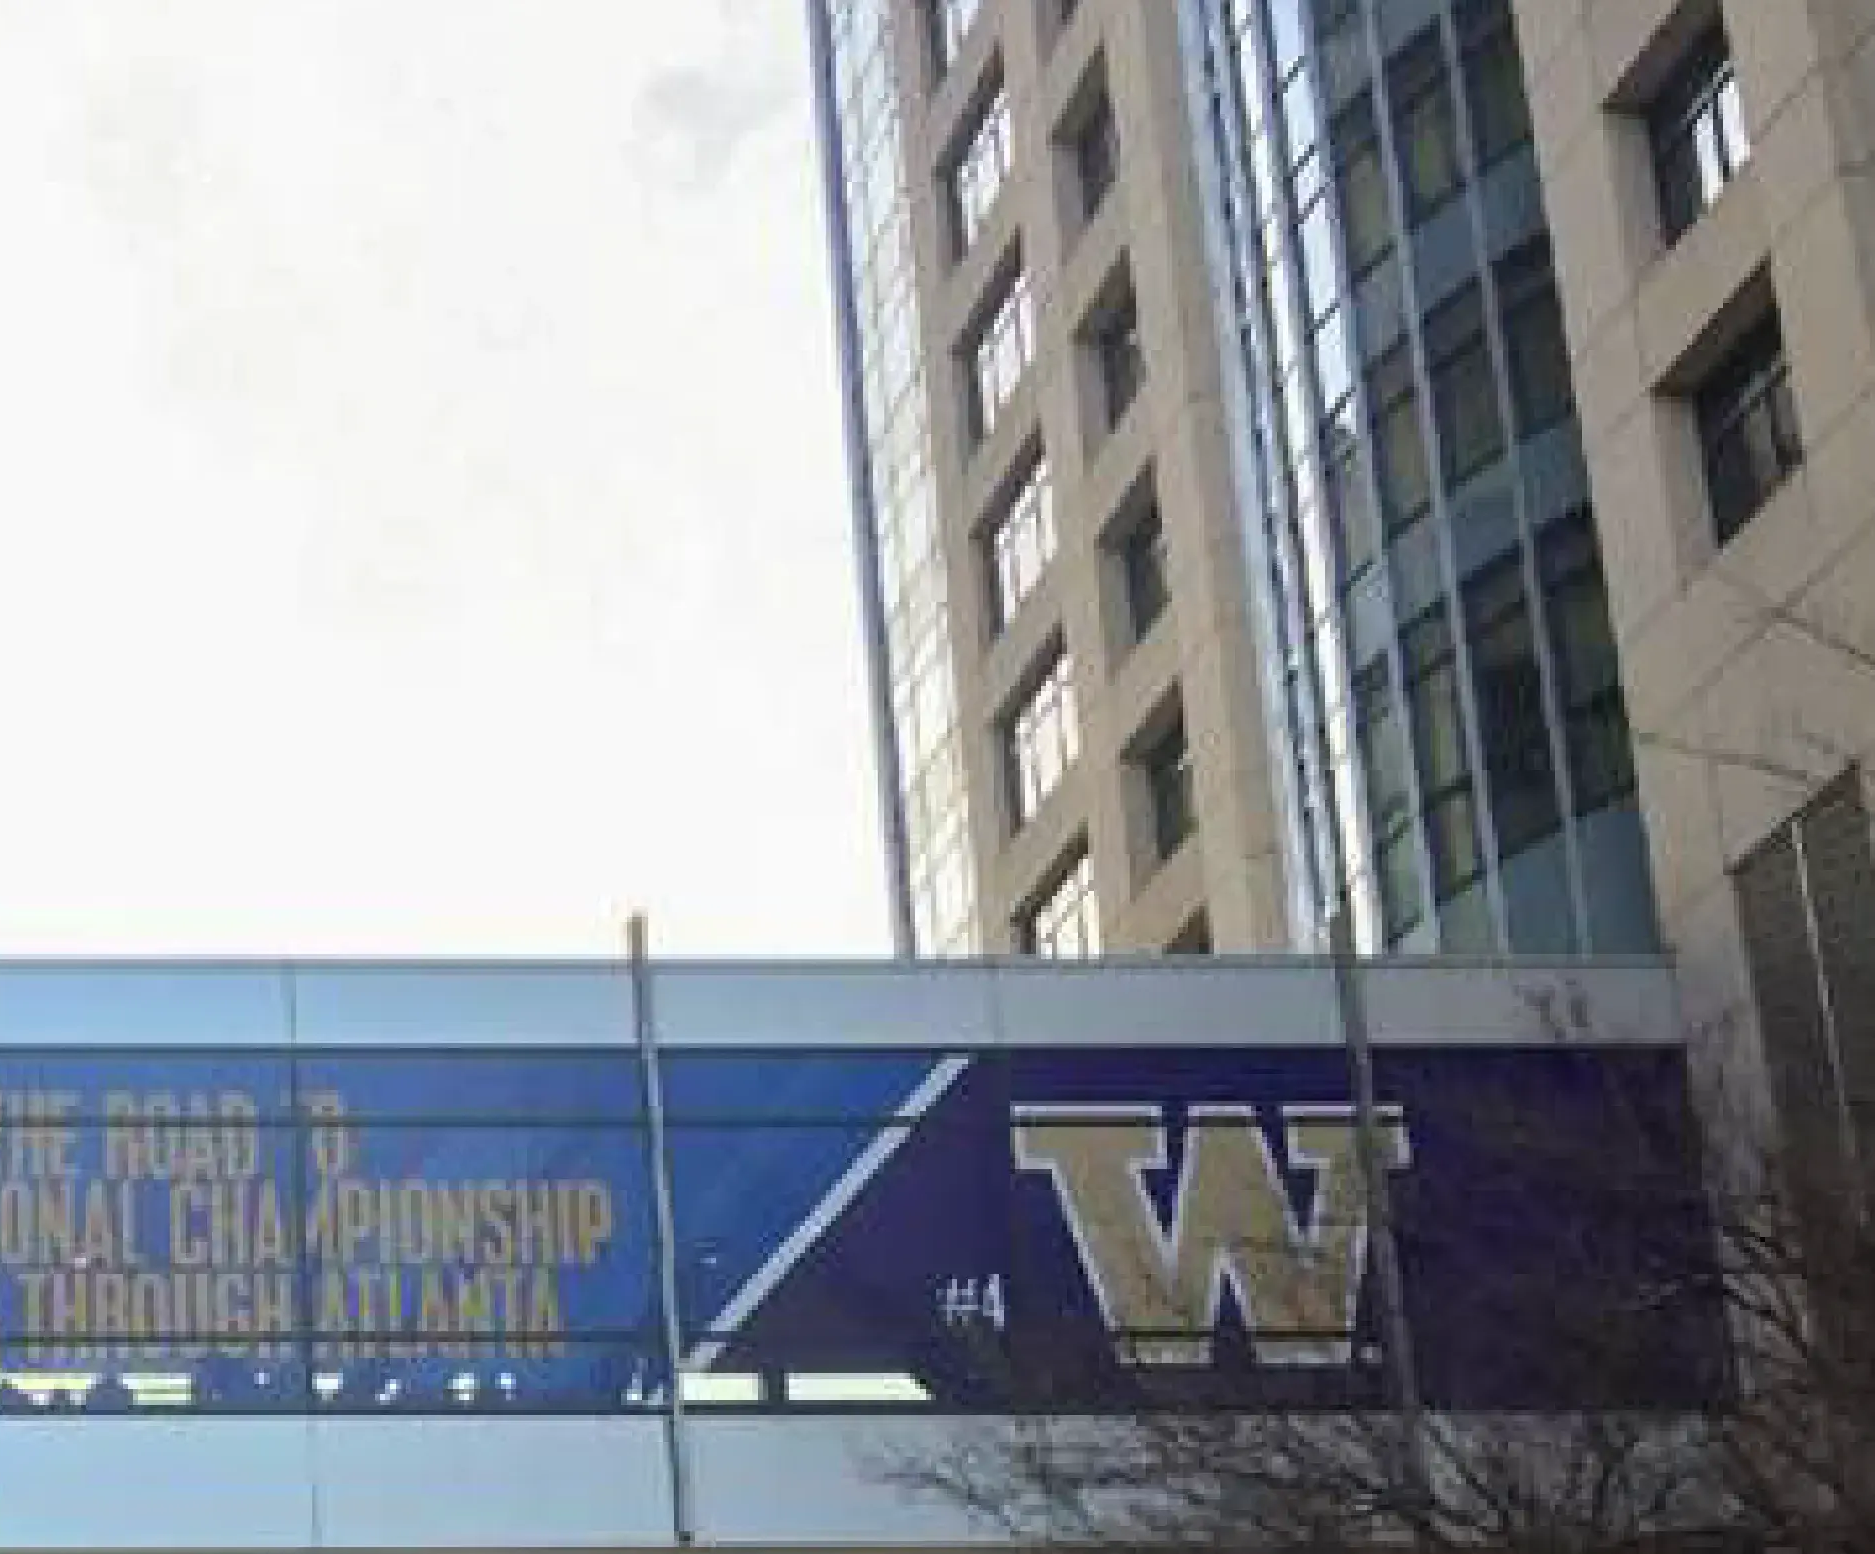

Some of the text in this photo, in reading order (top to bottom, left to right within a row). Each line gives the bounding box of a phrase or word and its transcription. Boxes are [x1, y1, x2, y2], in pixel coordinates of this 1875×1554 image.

[101, 1089, 259, 1176] ROAD
[1011, 1105, 1412, 1364] W
[17, 1272, 293, 1358] THROUGH
[313, 1272, 571, 1358] ATLANTA
[935, 1273, 1005, 1331] #4
